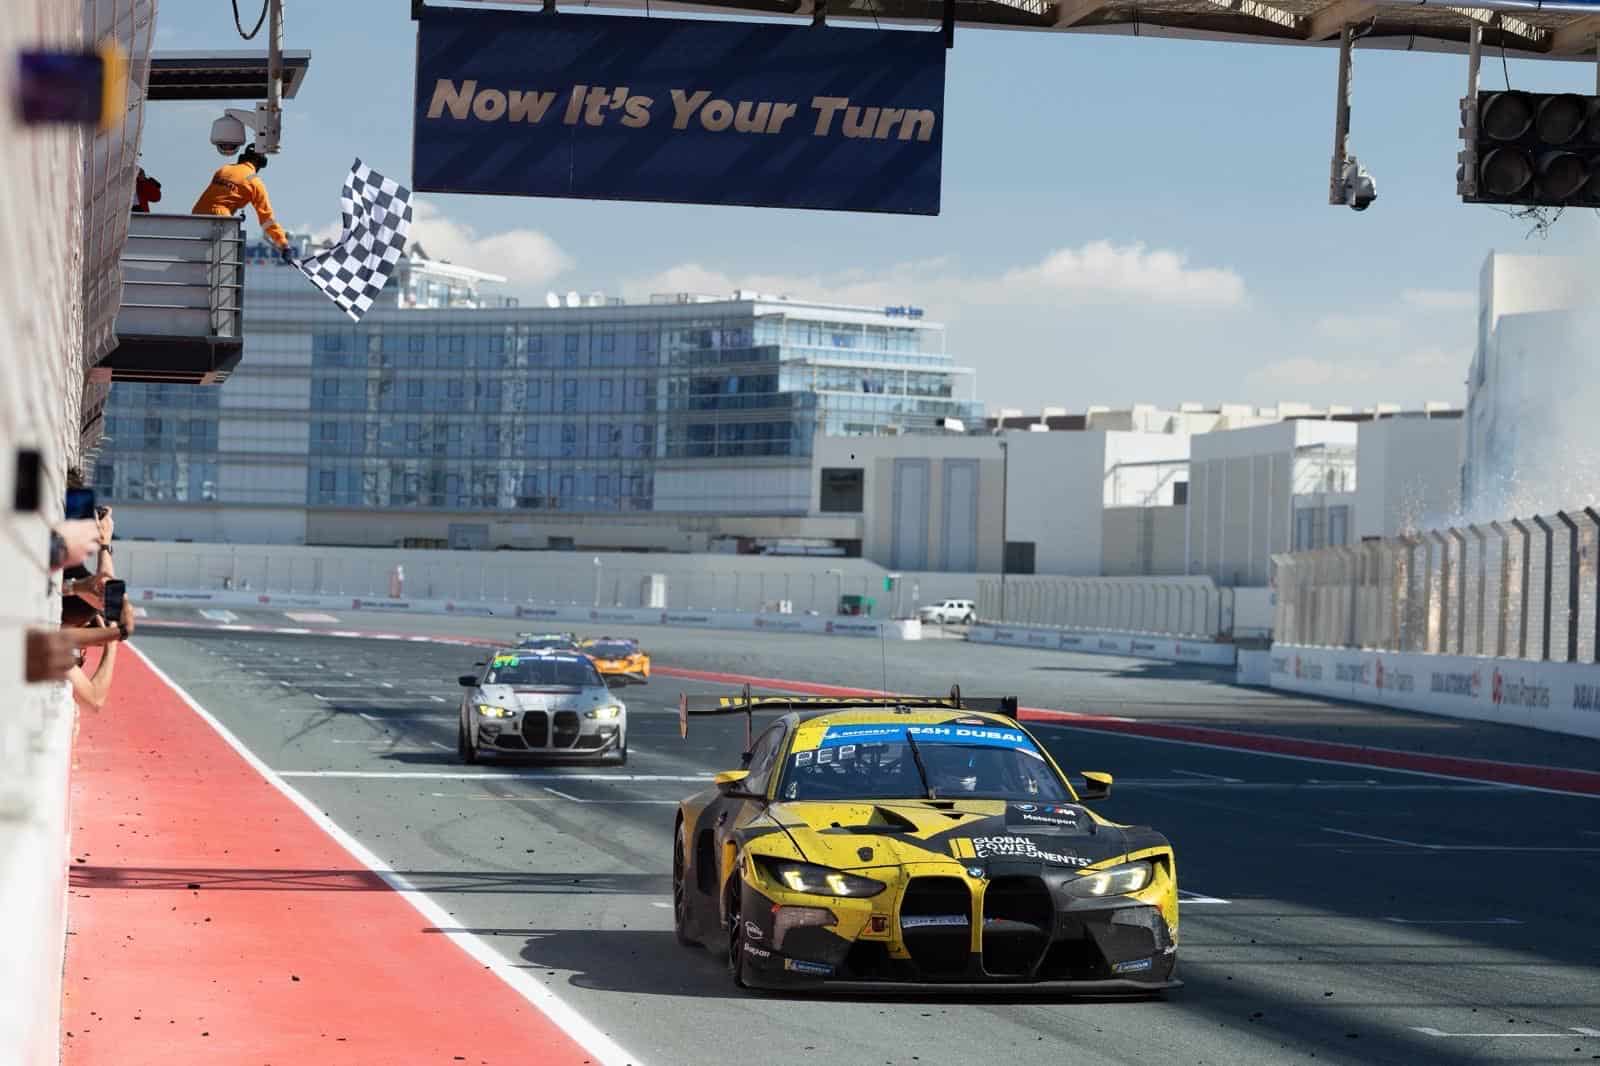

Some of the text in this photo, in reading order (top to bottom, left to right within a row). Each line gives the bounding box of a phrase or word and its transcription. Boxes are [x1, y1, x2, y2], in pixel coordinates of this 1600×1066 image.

[427, 79, 937, 142] Now It's Your Turn
[907, 727, 1023, 743] 24H DUBAI
[973, 836, 1036, 846] GLOBAL
[975, 843, 1037, 852] POWER
